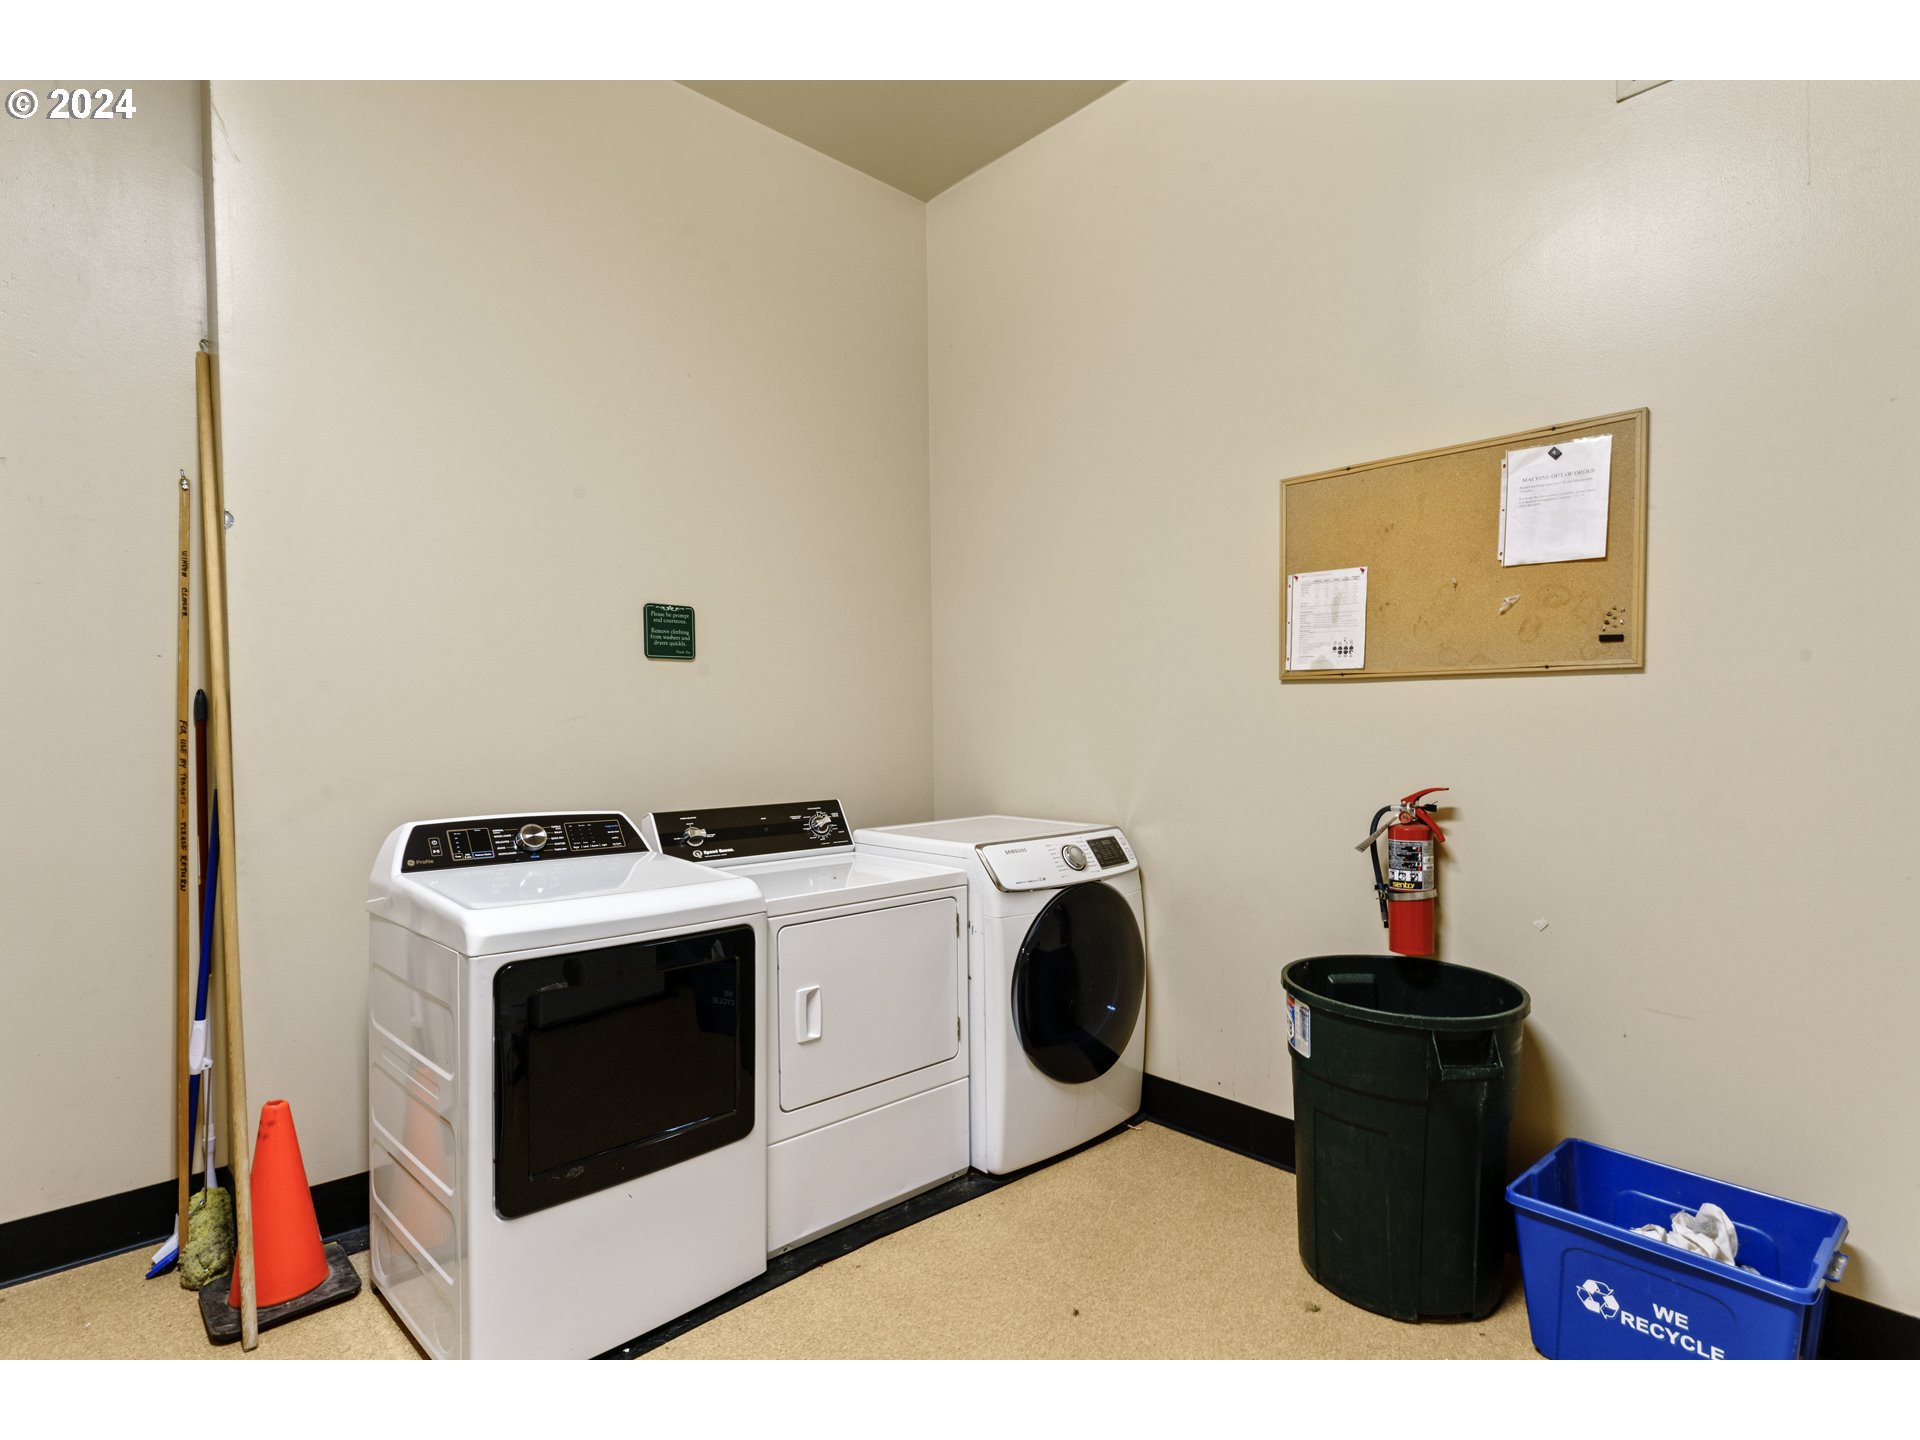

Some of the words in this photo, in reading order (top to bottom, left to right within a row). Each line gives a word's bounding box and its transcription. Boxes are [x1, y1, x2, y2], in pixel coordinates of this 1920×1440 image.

[1521, 474, 1550, 483] MACHINE
[179, 720, 188, 735] FOR
[179, 758, 187, 769] BY
[1652, 1303, 1689, 1330] WE
[1620, 1310, 1725, 1360] RECYCLE
